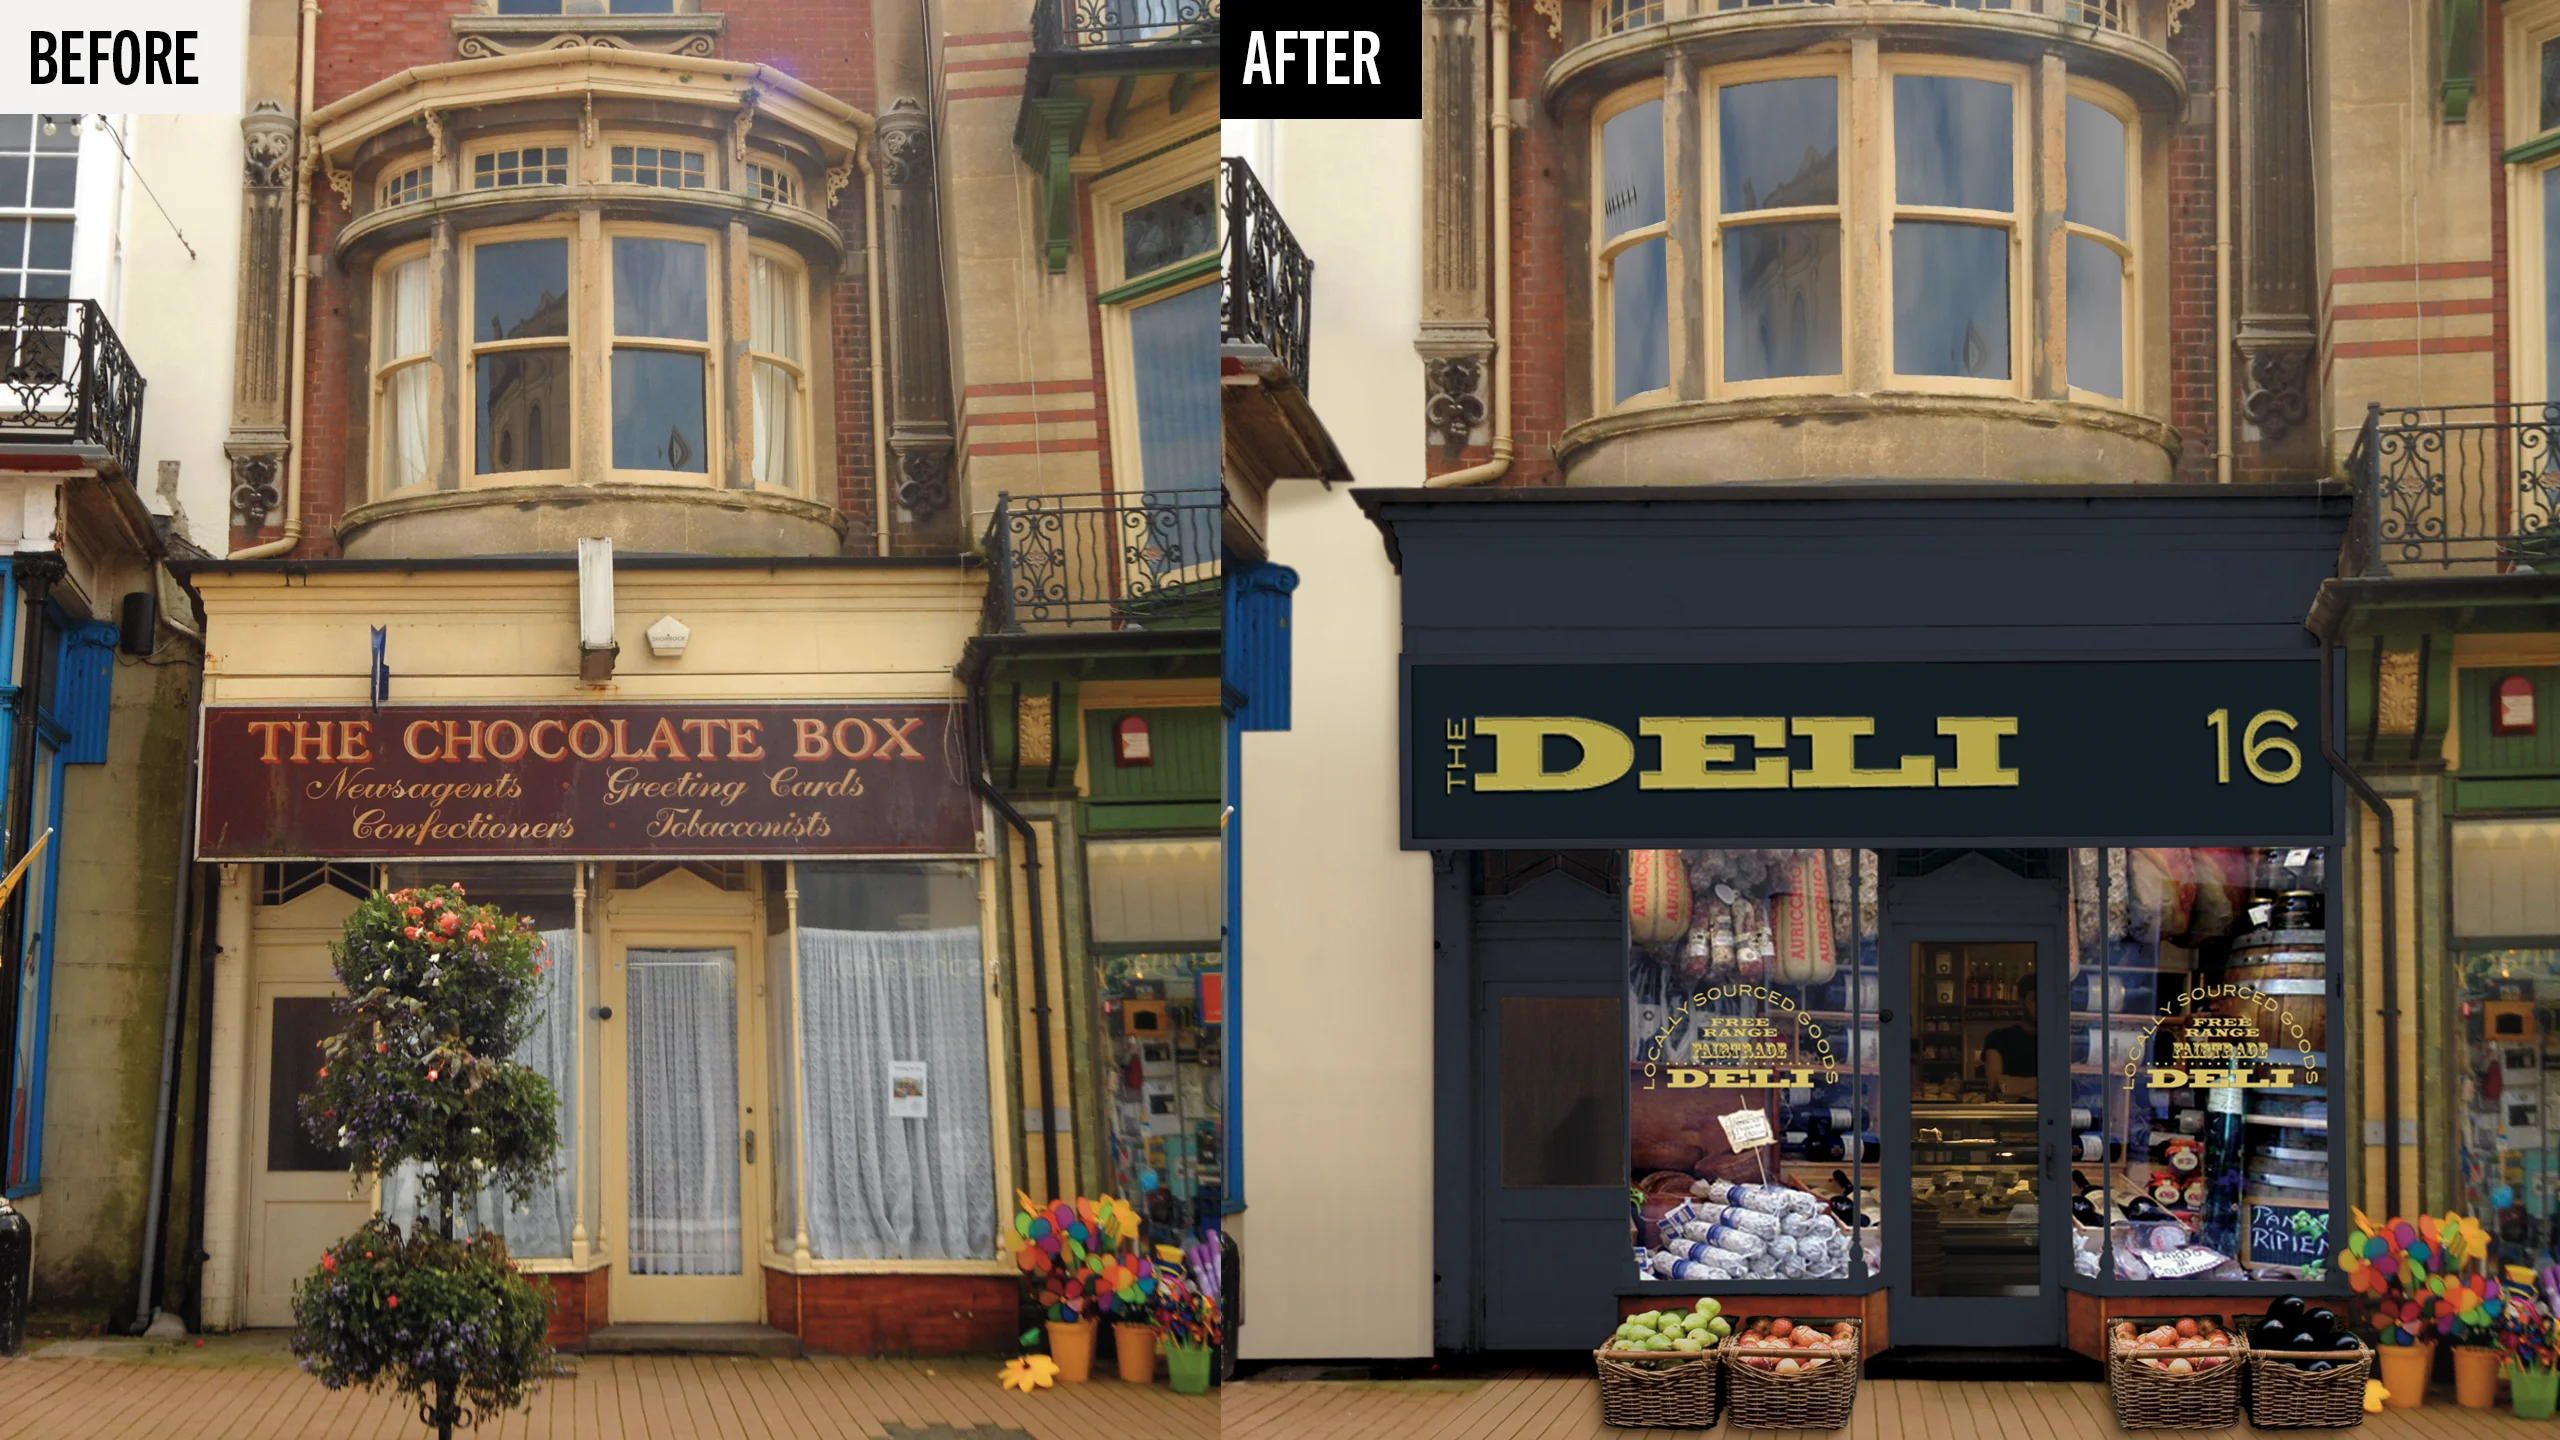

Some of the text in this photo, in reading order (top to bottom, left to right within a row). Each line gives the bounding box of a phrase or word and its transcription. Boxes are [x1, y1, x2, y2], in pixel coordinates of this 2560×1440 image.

[248, 717, 926, 764] THE CHOCOLATE BOX
[1447, 716, 2019, 795] THE DELI
[2207, 709, 2302, 785] 16
[306, 766, 523, 808] Newsagents
[603, 766, 865, 807] Greeting Cards
[353, 805, 575, 846] Confectioners
[646, 807, 832, 838] Tobacconists
[1643, 984, 1839, 1090] LOCALLY SOURCED GOODS
[1703, 1028, 1778, 1038] RANGE
[1710, 1017, 1770, 1027] FREE
[2122, 984, 2319, 1090] LOCALLY SOURCED GOODS
[2184, 1028, 2260, 1038] RANGE
[2193, 1017, 2252, 1027] FREE
[1691, 1041, 1788, 1059] FAIRTRADE
[2172, 1041, 2269, 1059] FAIRTRADE
[1667, 1068, 1815, 1088] DELI
[2146, 1068, 2295, 1088] DELI
